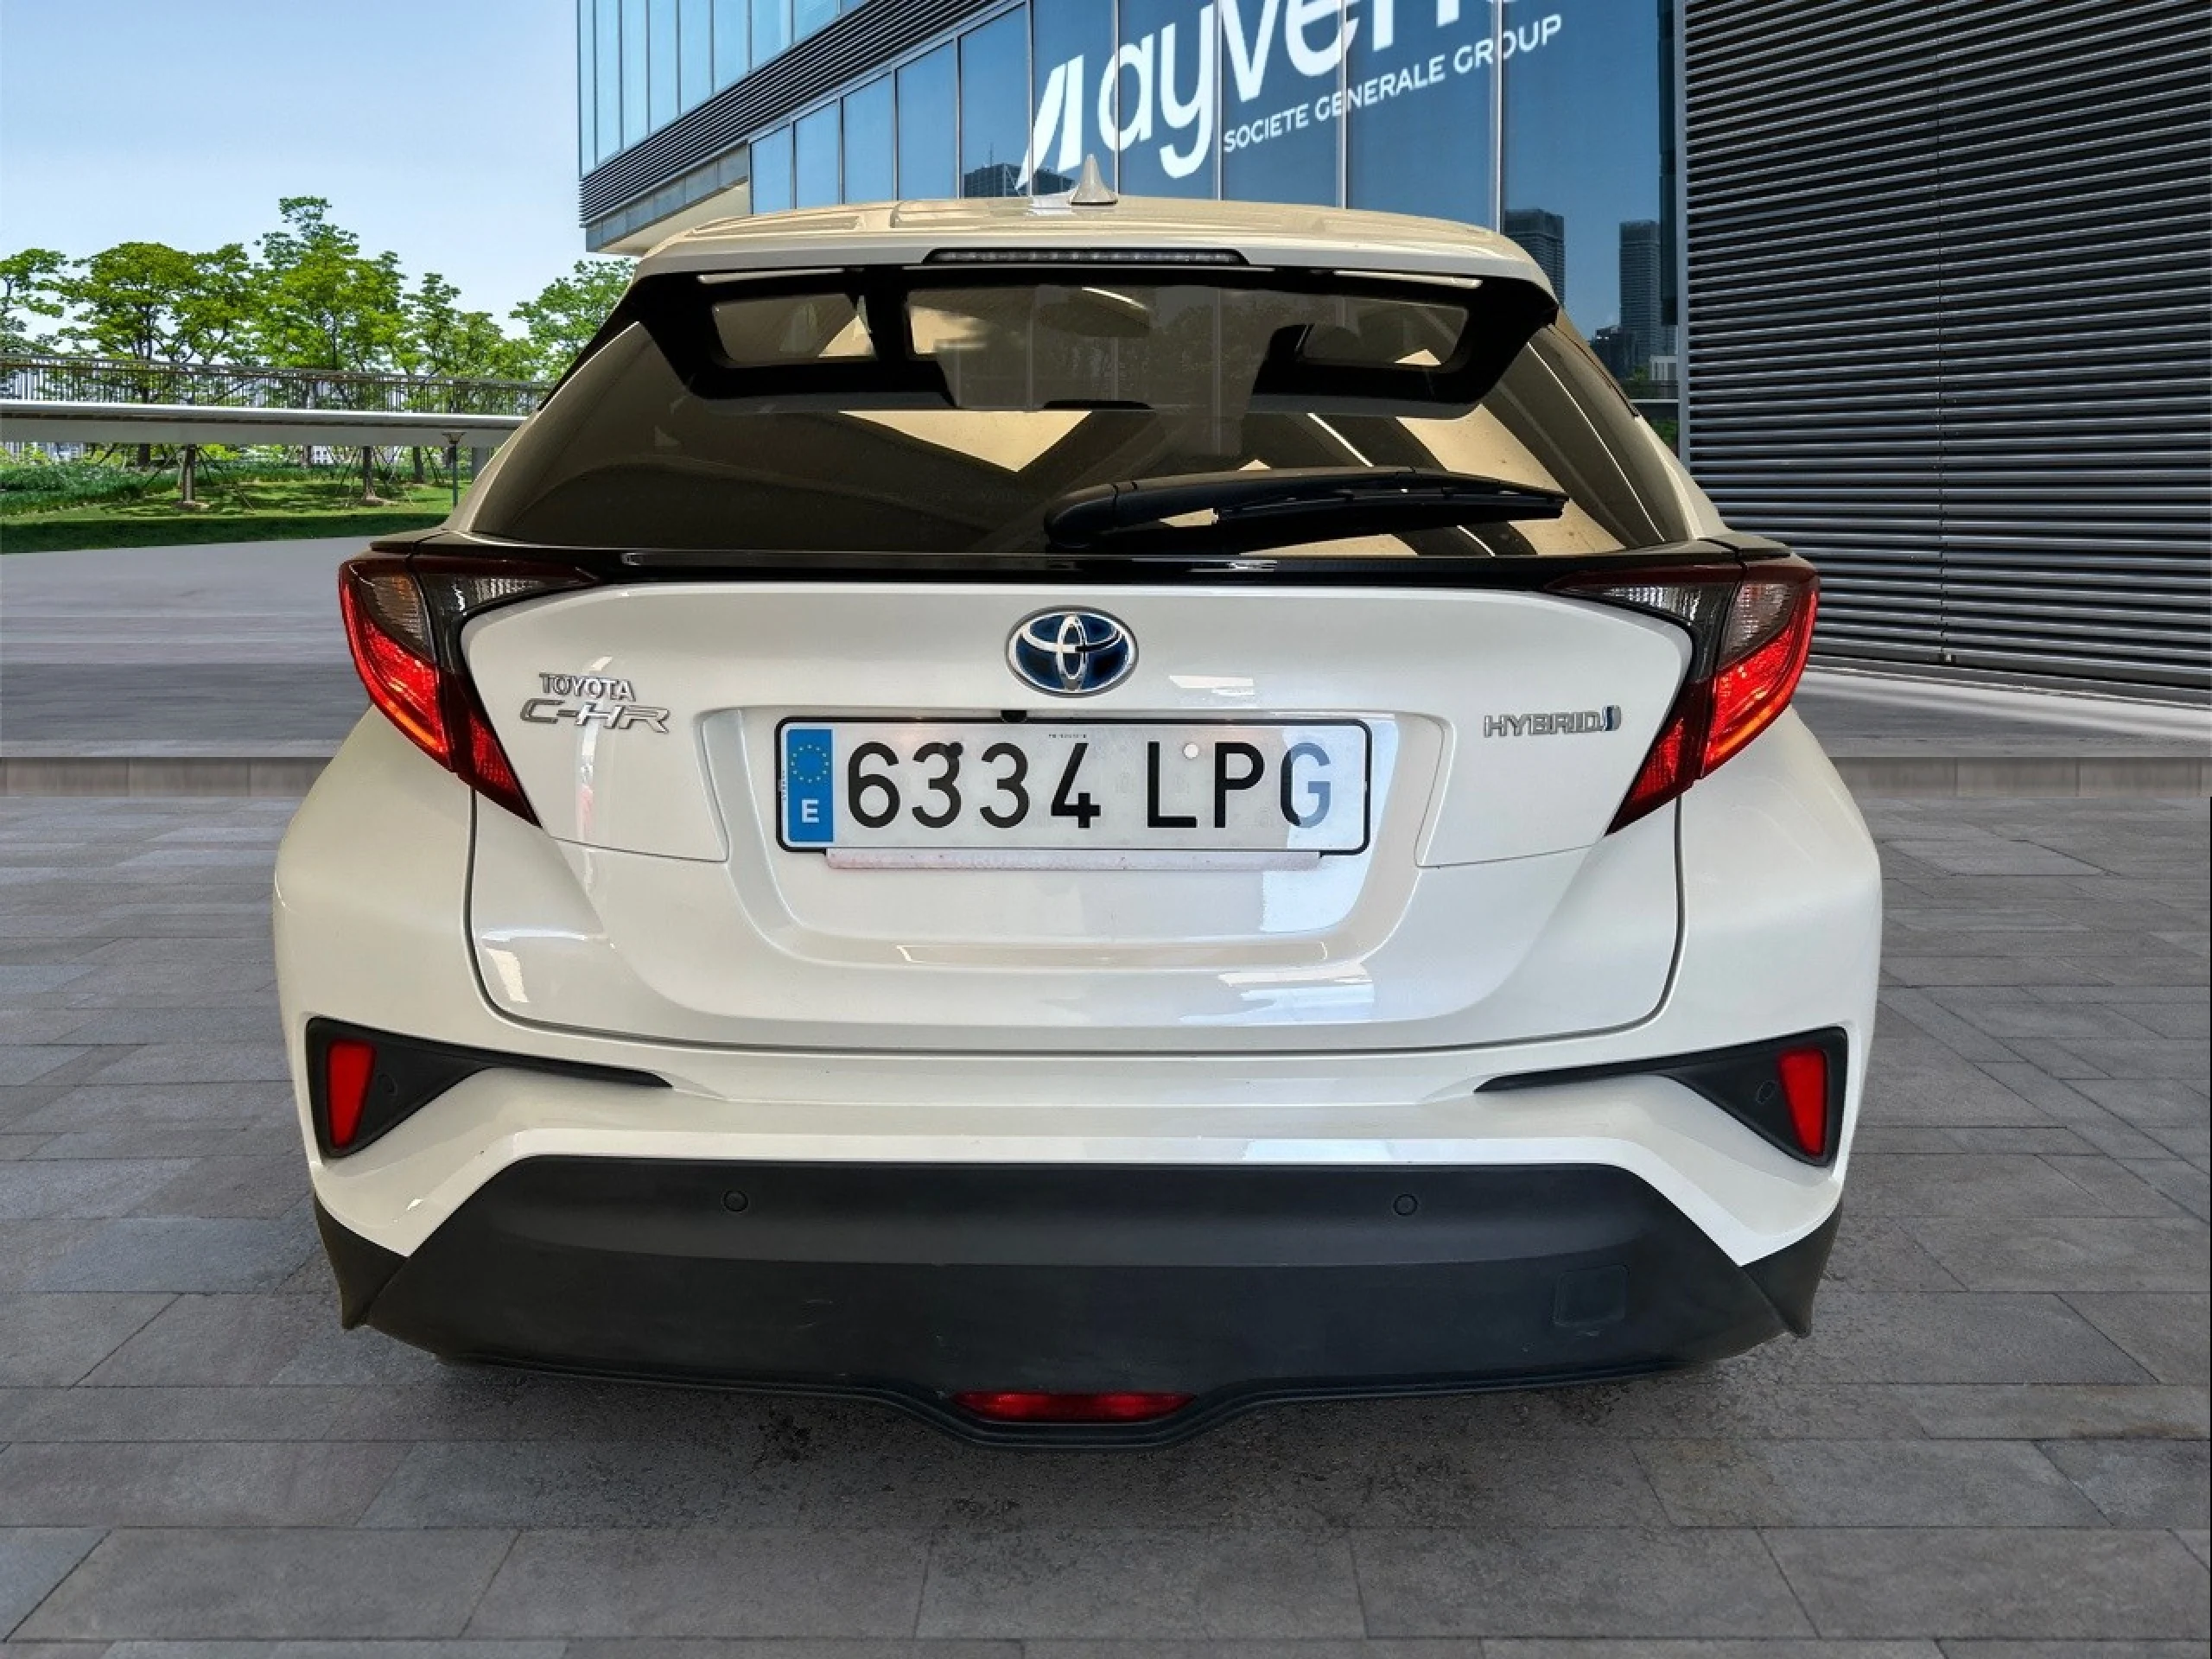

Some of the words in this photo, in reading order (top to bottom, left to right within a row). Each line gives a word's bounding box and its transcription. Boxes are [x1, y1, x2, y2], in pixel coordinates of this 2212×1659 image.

[1097, 0, 1516, 179] ayve
[1223, 103, 1310, 153] SOCIETE
[1314, 54, 1446, 122] GENERALE
[1452, 13, 1562, 74] GROUP
[538, 671, 637, 702] TOYOTA
[519, 698, 671, 734] C-HR
[1483, 710, 1603, 738] HYBRID
[847, 741, 1102, 830] 6334
[1147, 741, 1332, 830] LPG
[801, 799, 820, 823] E
